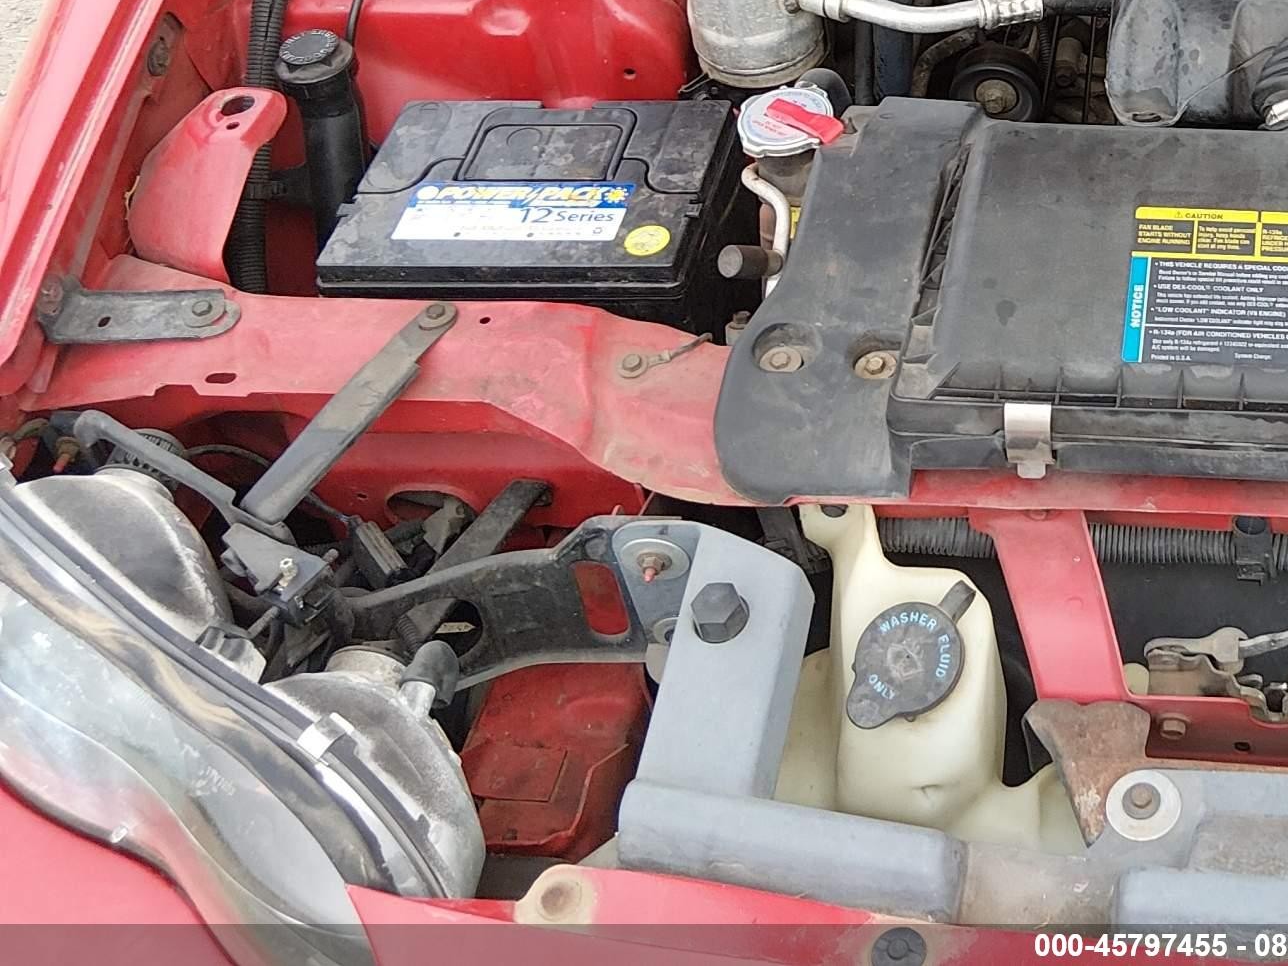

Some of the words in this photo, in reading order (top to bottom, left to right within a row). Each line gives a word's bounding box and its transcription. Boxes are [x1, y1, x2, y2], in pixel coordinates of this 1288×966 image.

[520, 208, 552, 223] 12
[557, 210, 614, 222] Series
[1185, 212, 1224, 220] CAUTION
[1130, 285, 1144, 328] NOTICE
[1206, 331, 1251, 339] CONDITIONED
[879, 611, 937, 635] WASHER
[935, 634, 952, 679] FLUID
[868, 674, 896, 701] ONLY
